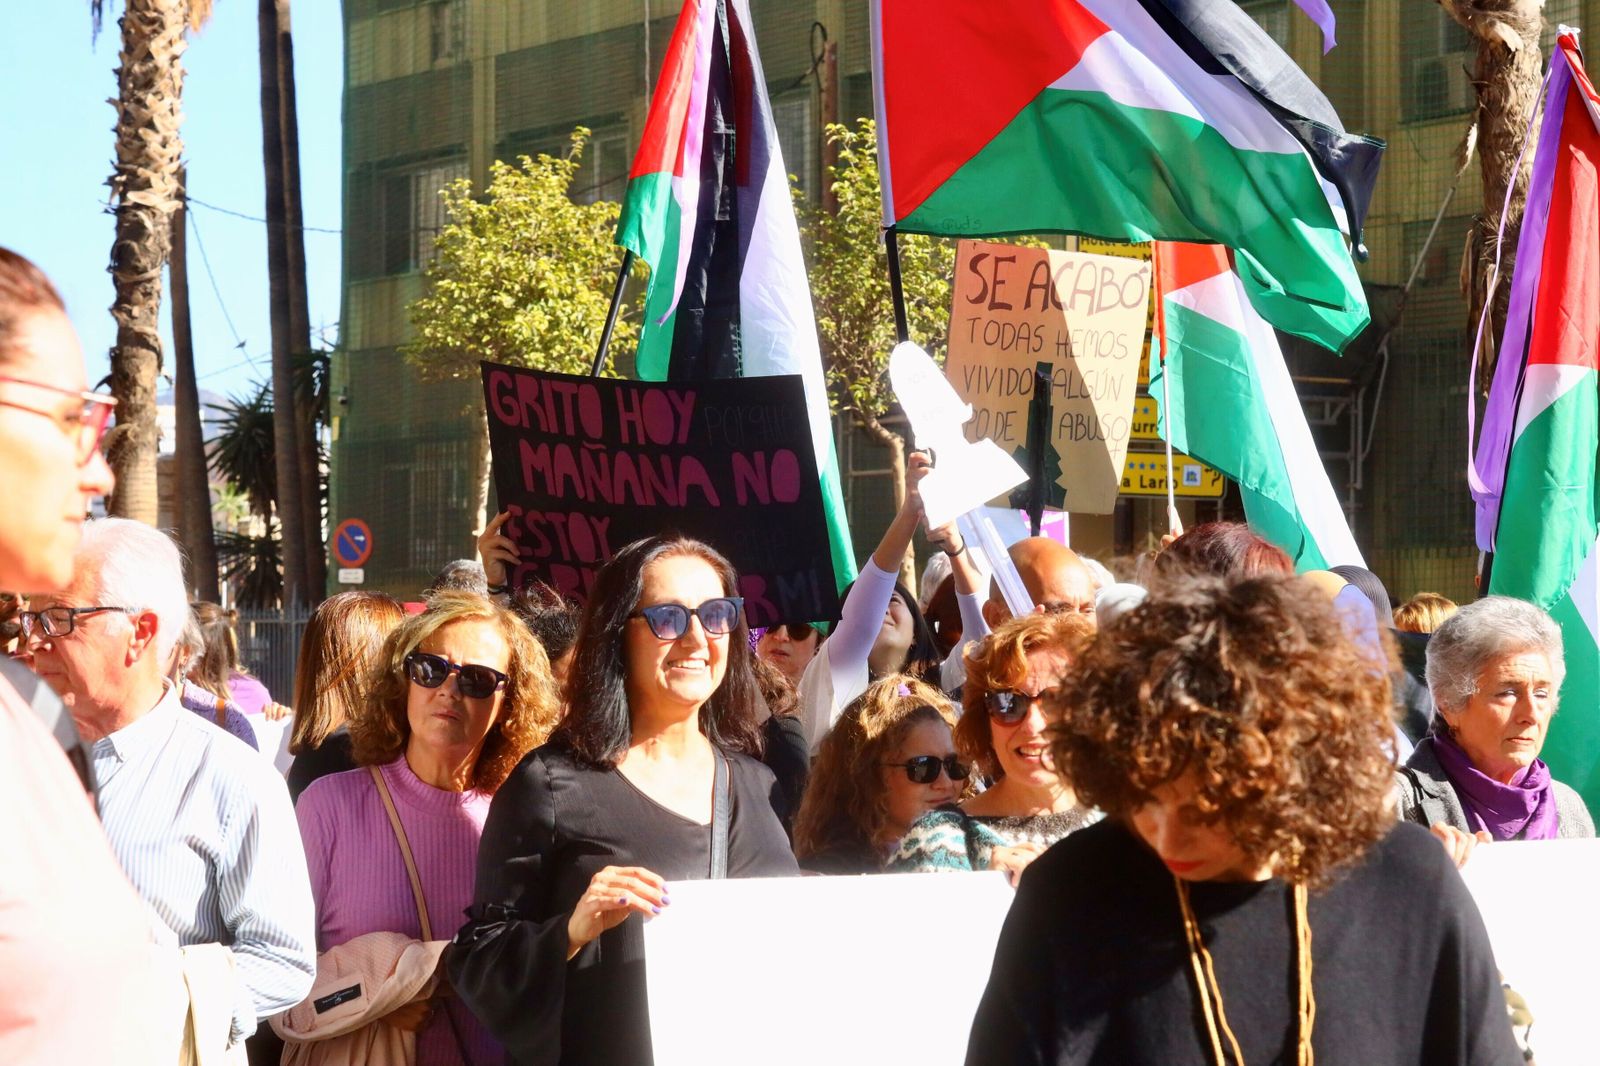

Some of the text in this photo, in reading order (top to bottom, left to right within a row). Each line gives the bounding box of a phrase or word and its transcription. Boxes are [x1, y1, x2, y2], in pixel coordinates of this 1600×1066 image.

[966, 253, 1150, 317] SE ACABÓ
[966, 316, 1128, 360] TODAS HEMOS
[489, 371, 602, 439] GRITO
[616, 386, 697, 446] HOY
[963, 365, 1034, 396] VIVIDO
[1052, 366, 1125, 401] ALGÚN
[965, 408, 990, 440] PO
[994, 411, 1017, 442] DE
[1059, 408, 1128, 442] ABUSO
[518, 438, 801, 507] MAÑANA NO
[507, 504, 611, 563] ESTOY
